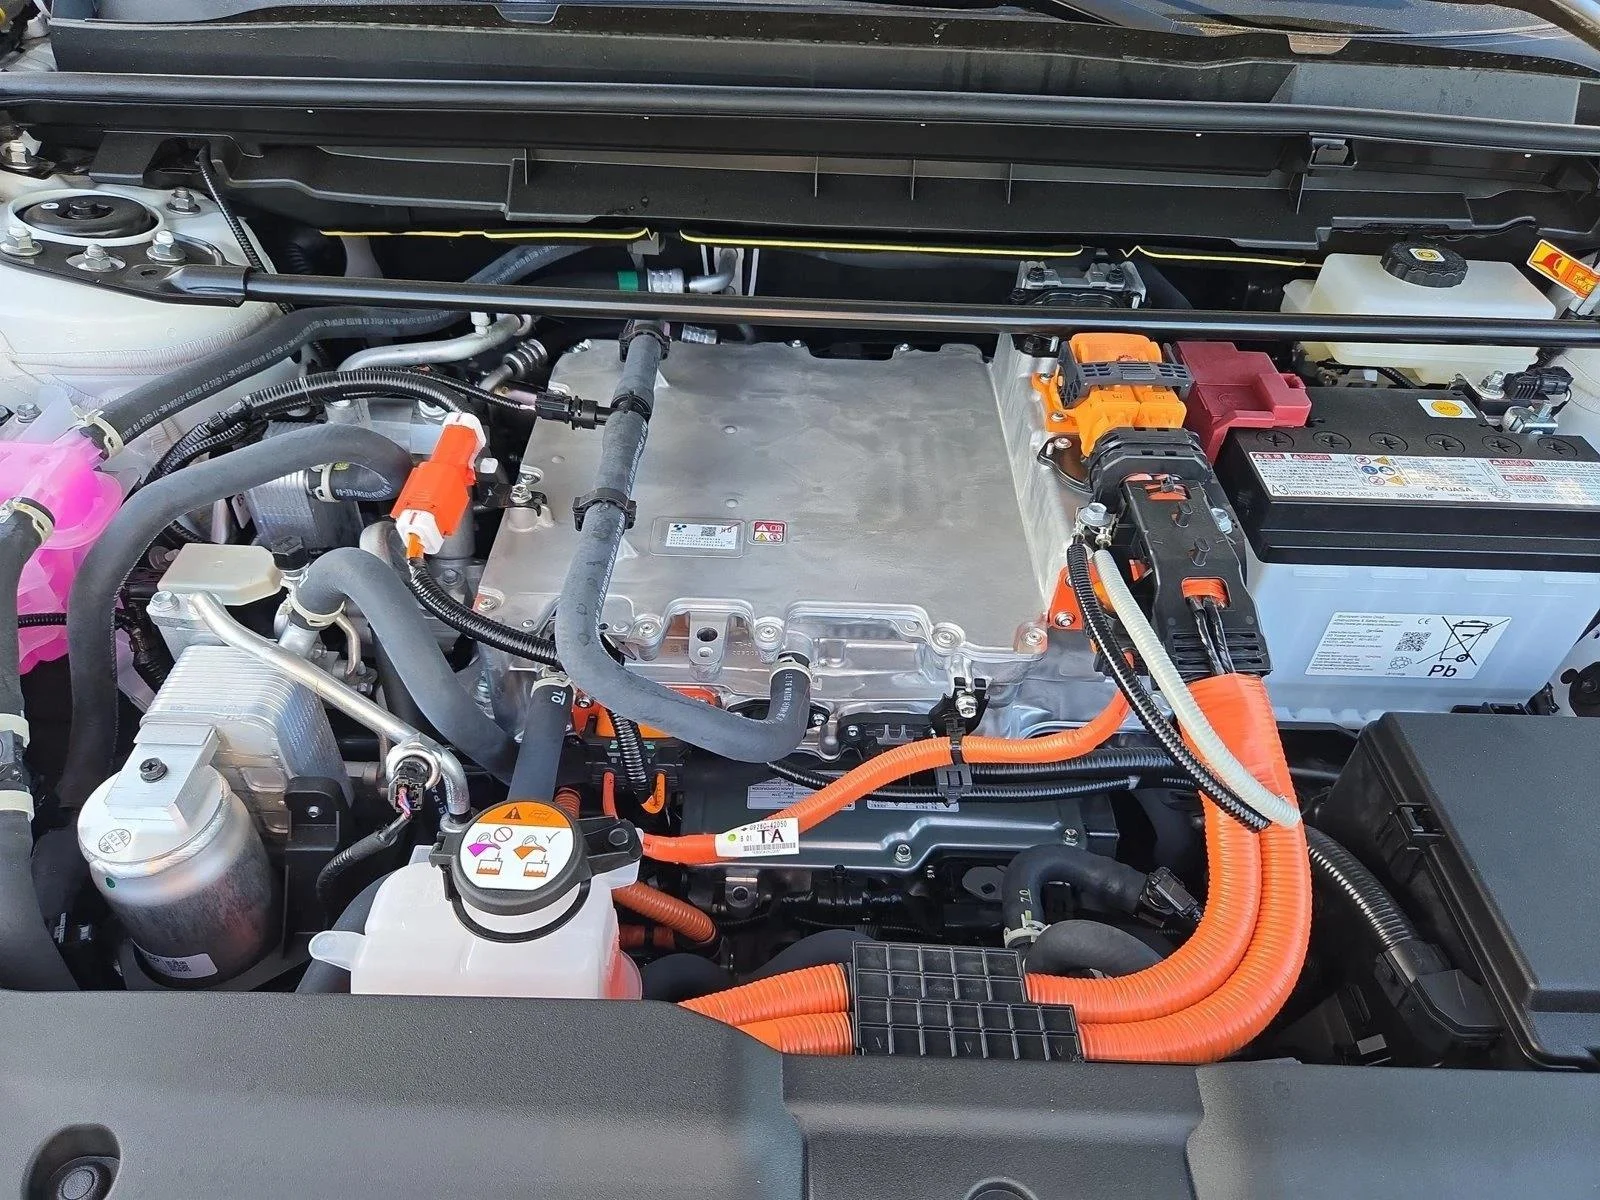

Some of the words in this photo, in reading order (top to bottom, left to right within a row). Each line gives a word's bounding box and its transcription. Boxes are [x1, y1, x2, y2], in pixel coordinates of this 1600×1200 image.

[1271, 484, 1289, 495] A3
[1428, 664, 1457, 678] Pb
[757, 828, 784, 844] TA
